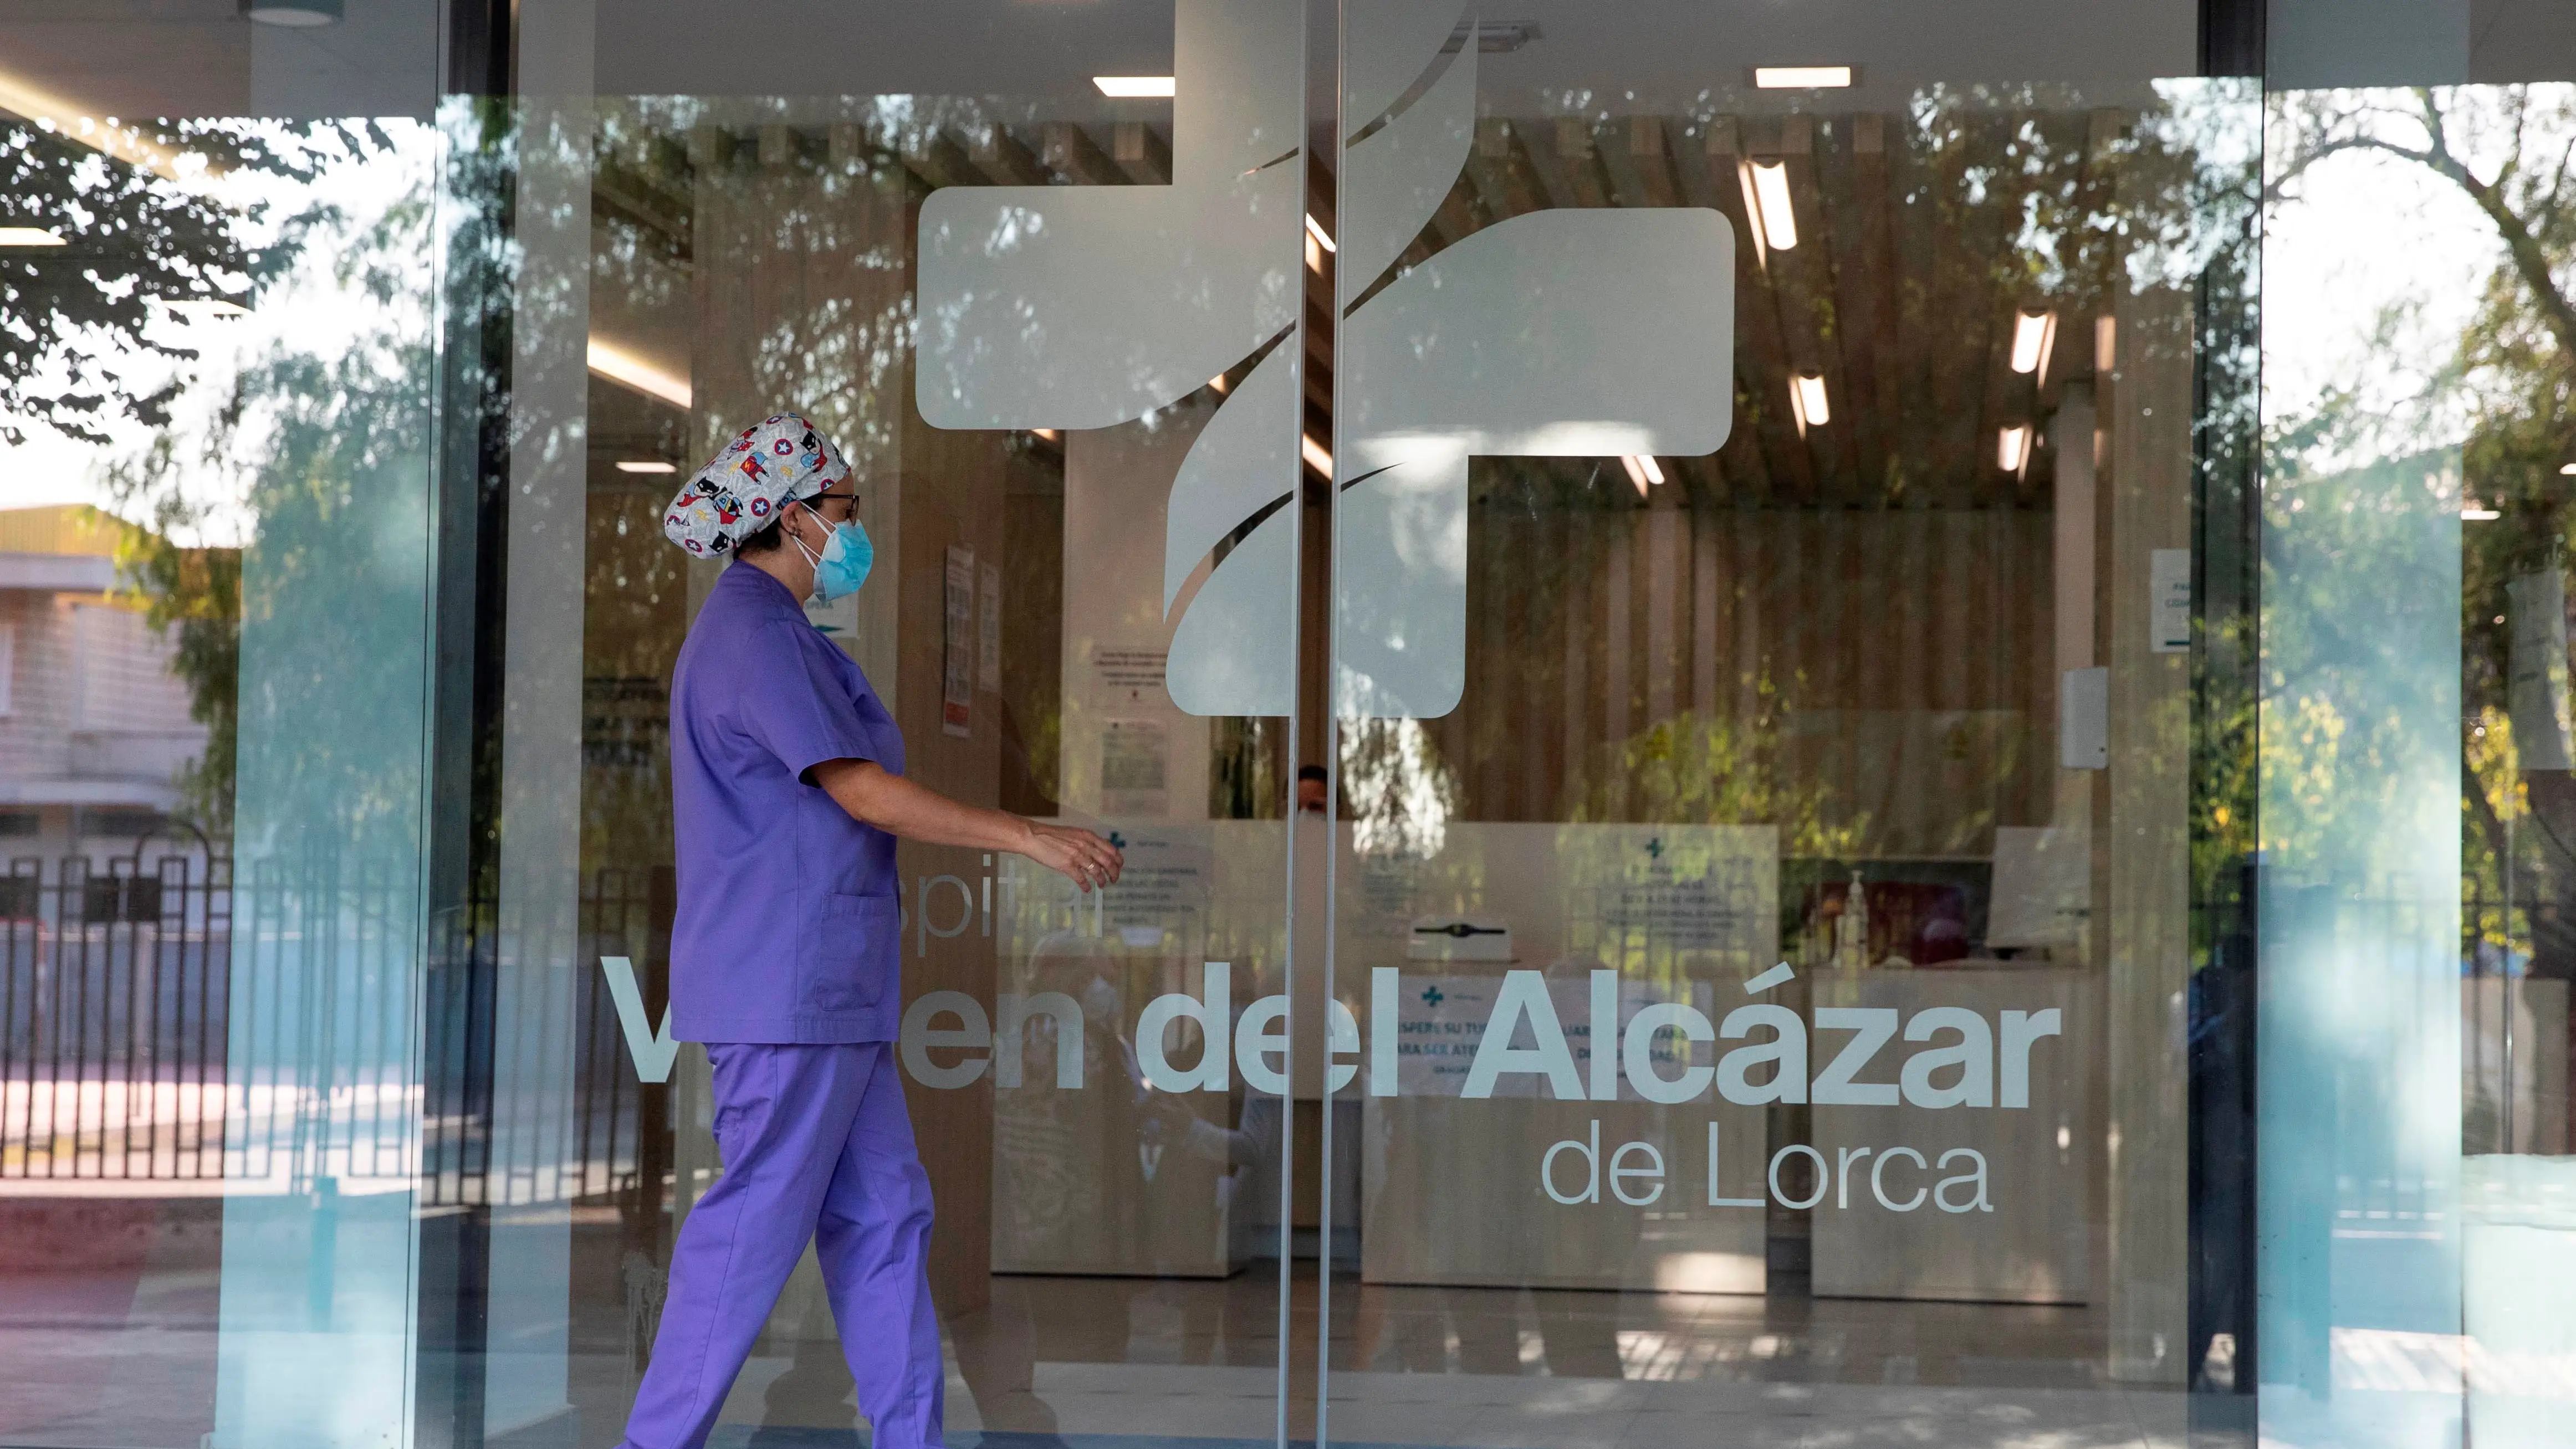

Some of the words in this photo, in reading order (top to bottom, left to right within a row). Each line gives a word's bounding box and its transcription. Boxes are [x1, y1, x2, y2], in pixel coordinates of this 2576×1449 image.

[899, 854, 1103, 958] pital
[600, 956, 1084, 1089] Ven
[1136, 962, 1399, 1097] del
[1460, 961, 2062, 1109] Alcázar
[1541, 1119, 1665, 1206] de
[1708, 1121, 1994, 1214] Lorca
